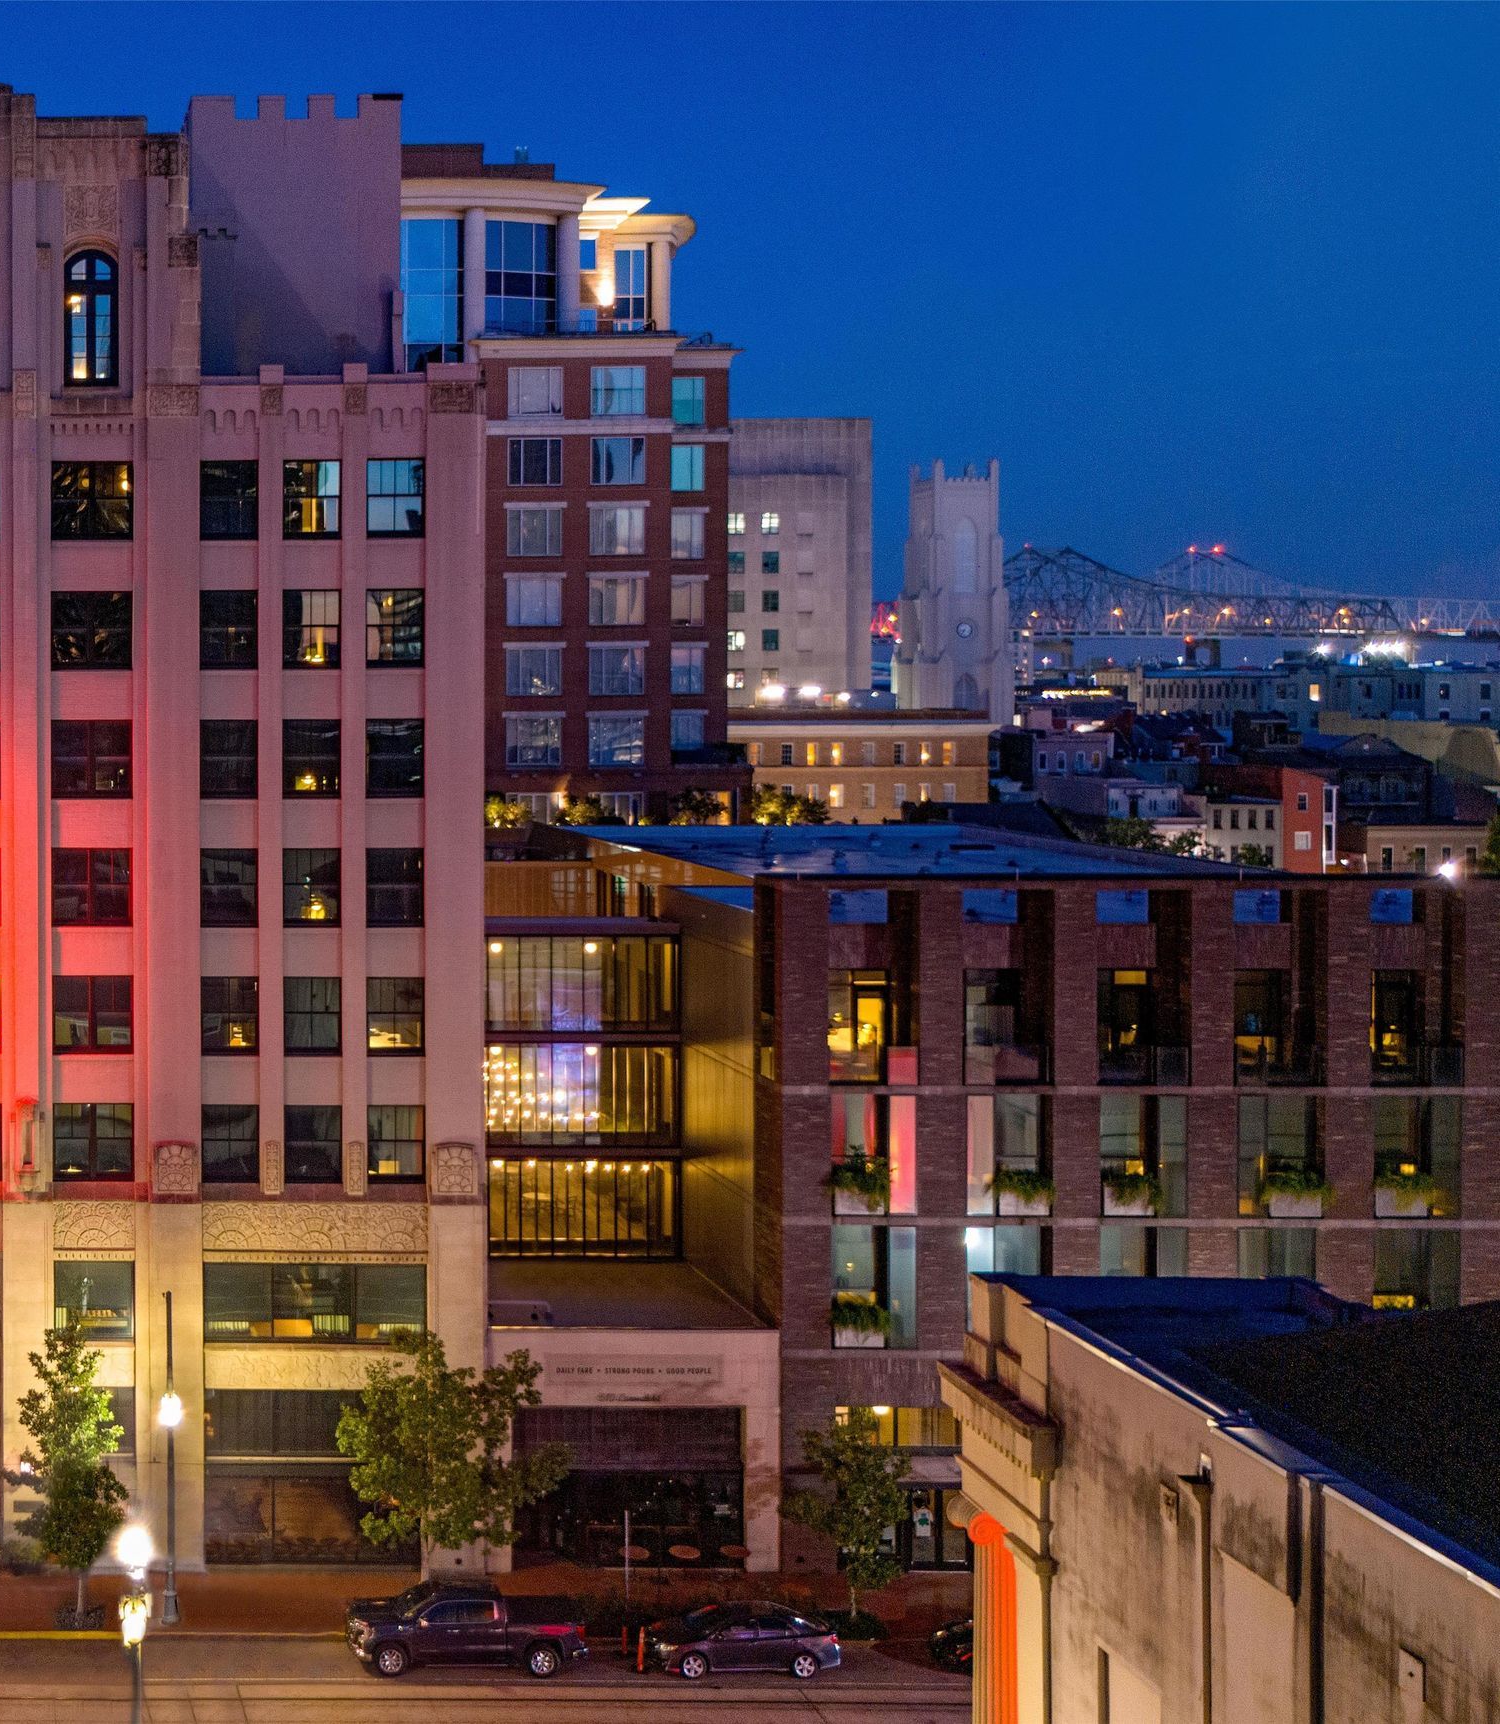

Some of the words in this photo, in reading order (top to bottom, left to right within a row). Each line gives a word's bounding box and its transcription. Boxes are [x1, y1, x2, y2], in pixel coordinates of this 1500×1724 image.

[556, 1366, 575, 1375] DAILY
[577, 1366, 594, 1375] FARE
[604, 1366, 631, 1375] STRONG
[632, 1366, 655, 1375] POURS
[666, 1366, 685, 1375] GOOD
[687, 1366, 712, 1375] PEOPLE
